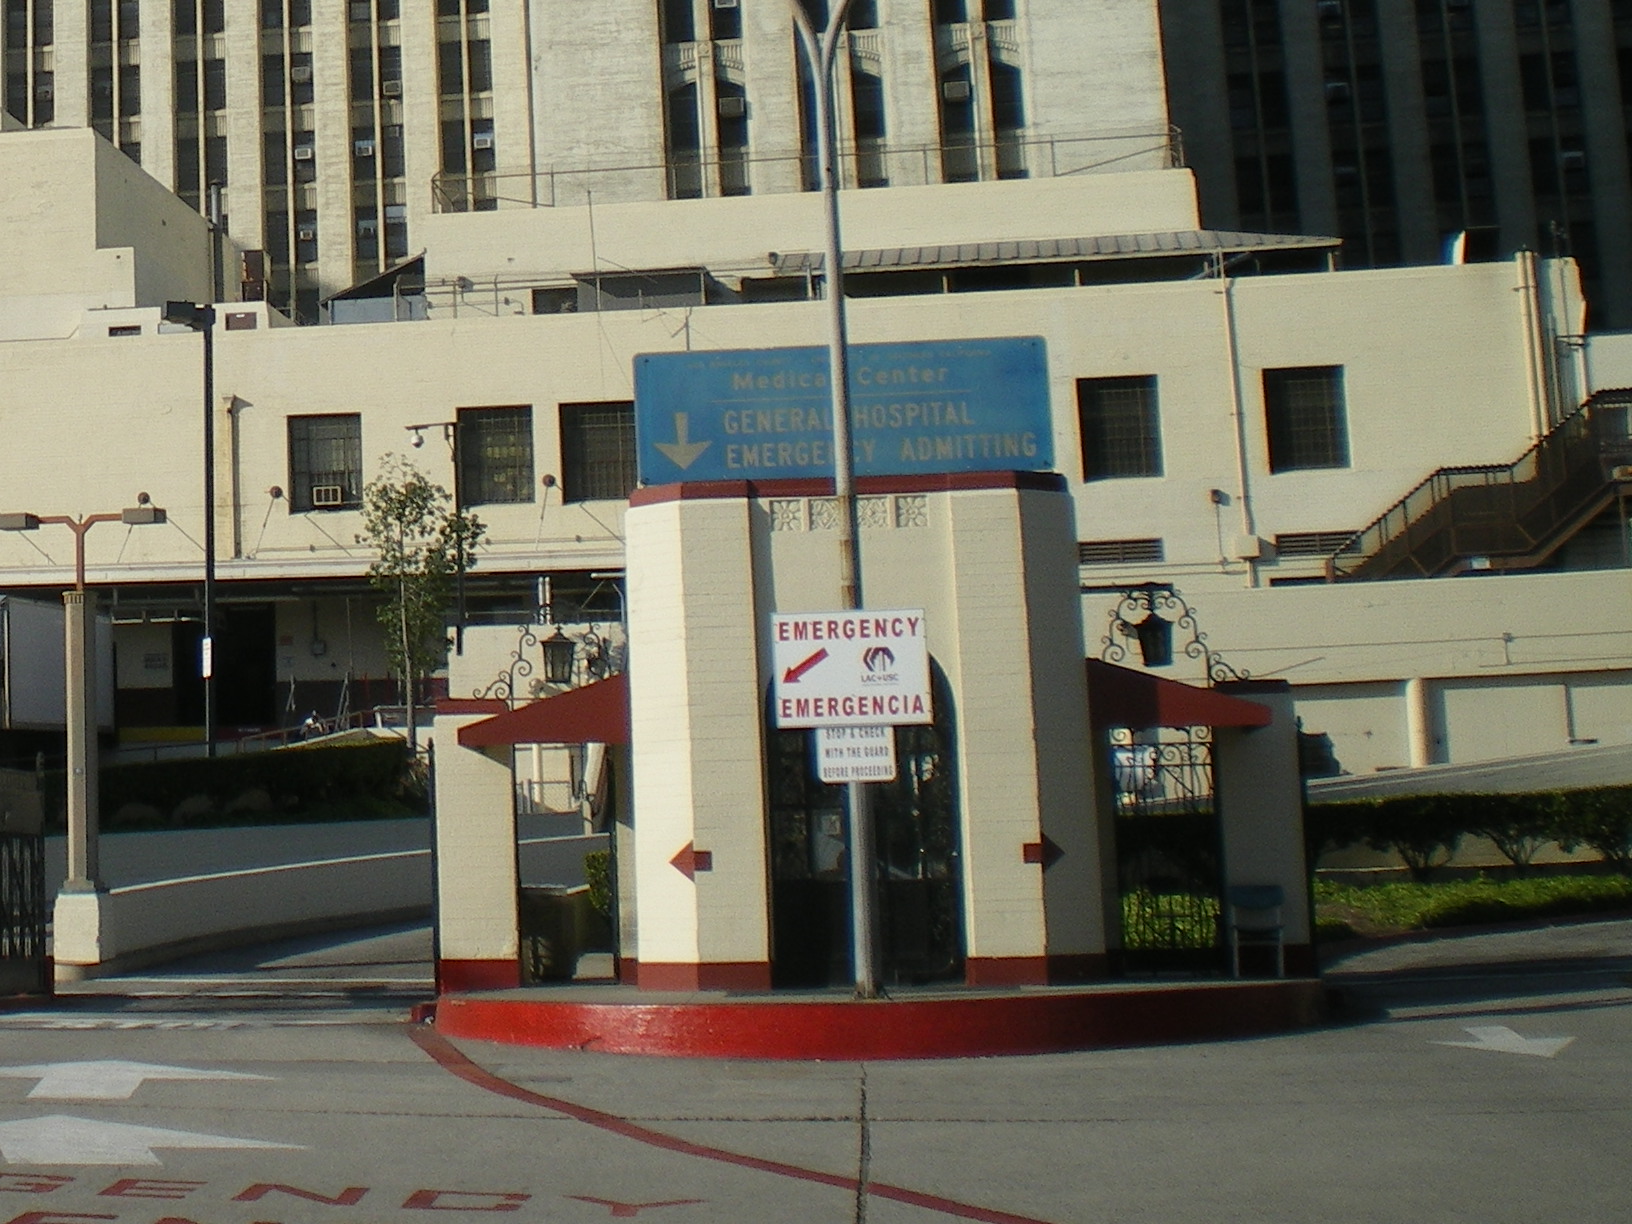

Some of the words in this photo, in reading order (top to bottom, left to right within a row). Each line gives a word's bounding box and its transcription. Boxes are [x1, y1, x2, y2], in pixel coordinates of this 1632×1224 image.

[731, 370, 829, 391] Medica
[856, 365, 949, 386] Center
[723, 407, 833, 435] GENERAL
[853, 401, 976, 429] HOSPITAL
[900, 432, 1038, 462] ADMITTING
[779, 617, 920, 641] EMERGENCY
[781, 694, 925, 718] EMERGENCIA
[826, 727, 847, 740] STOP
[859, 726, 886, 739] CHECK
[824, 747, 844, 759] WITH
[846, 746, 862, 758] THE
[864, 745, 889, 758] GUARD
[823, 766, 849, 778] BEFORE
[851, 765, 894, 777] PROCEEDING
